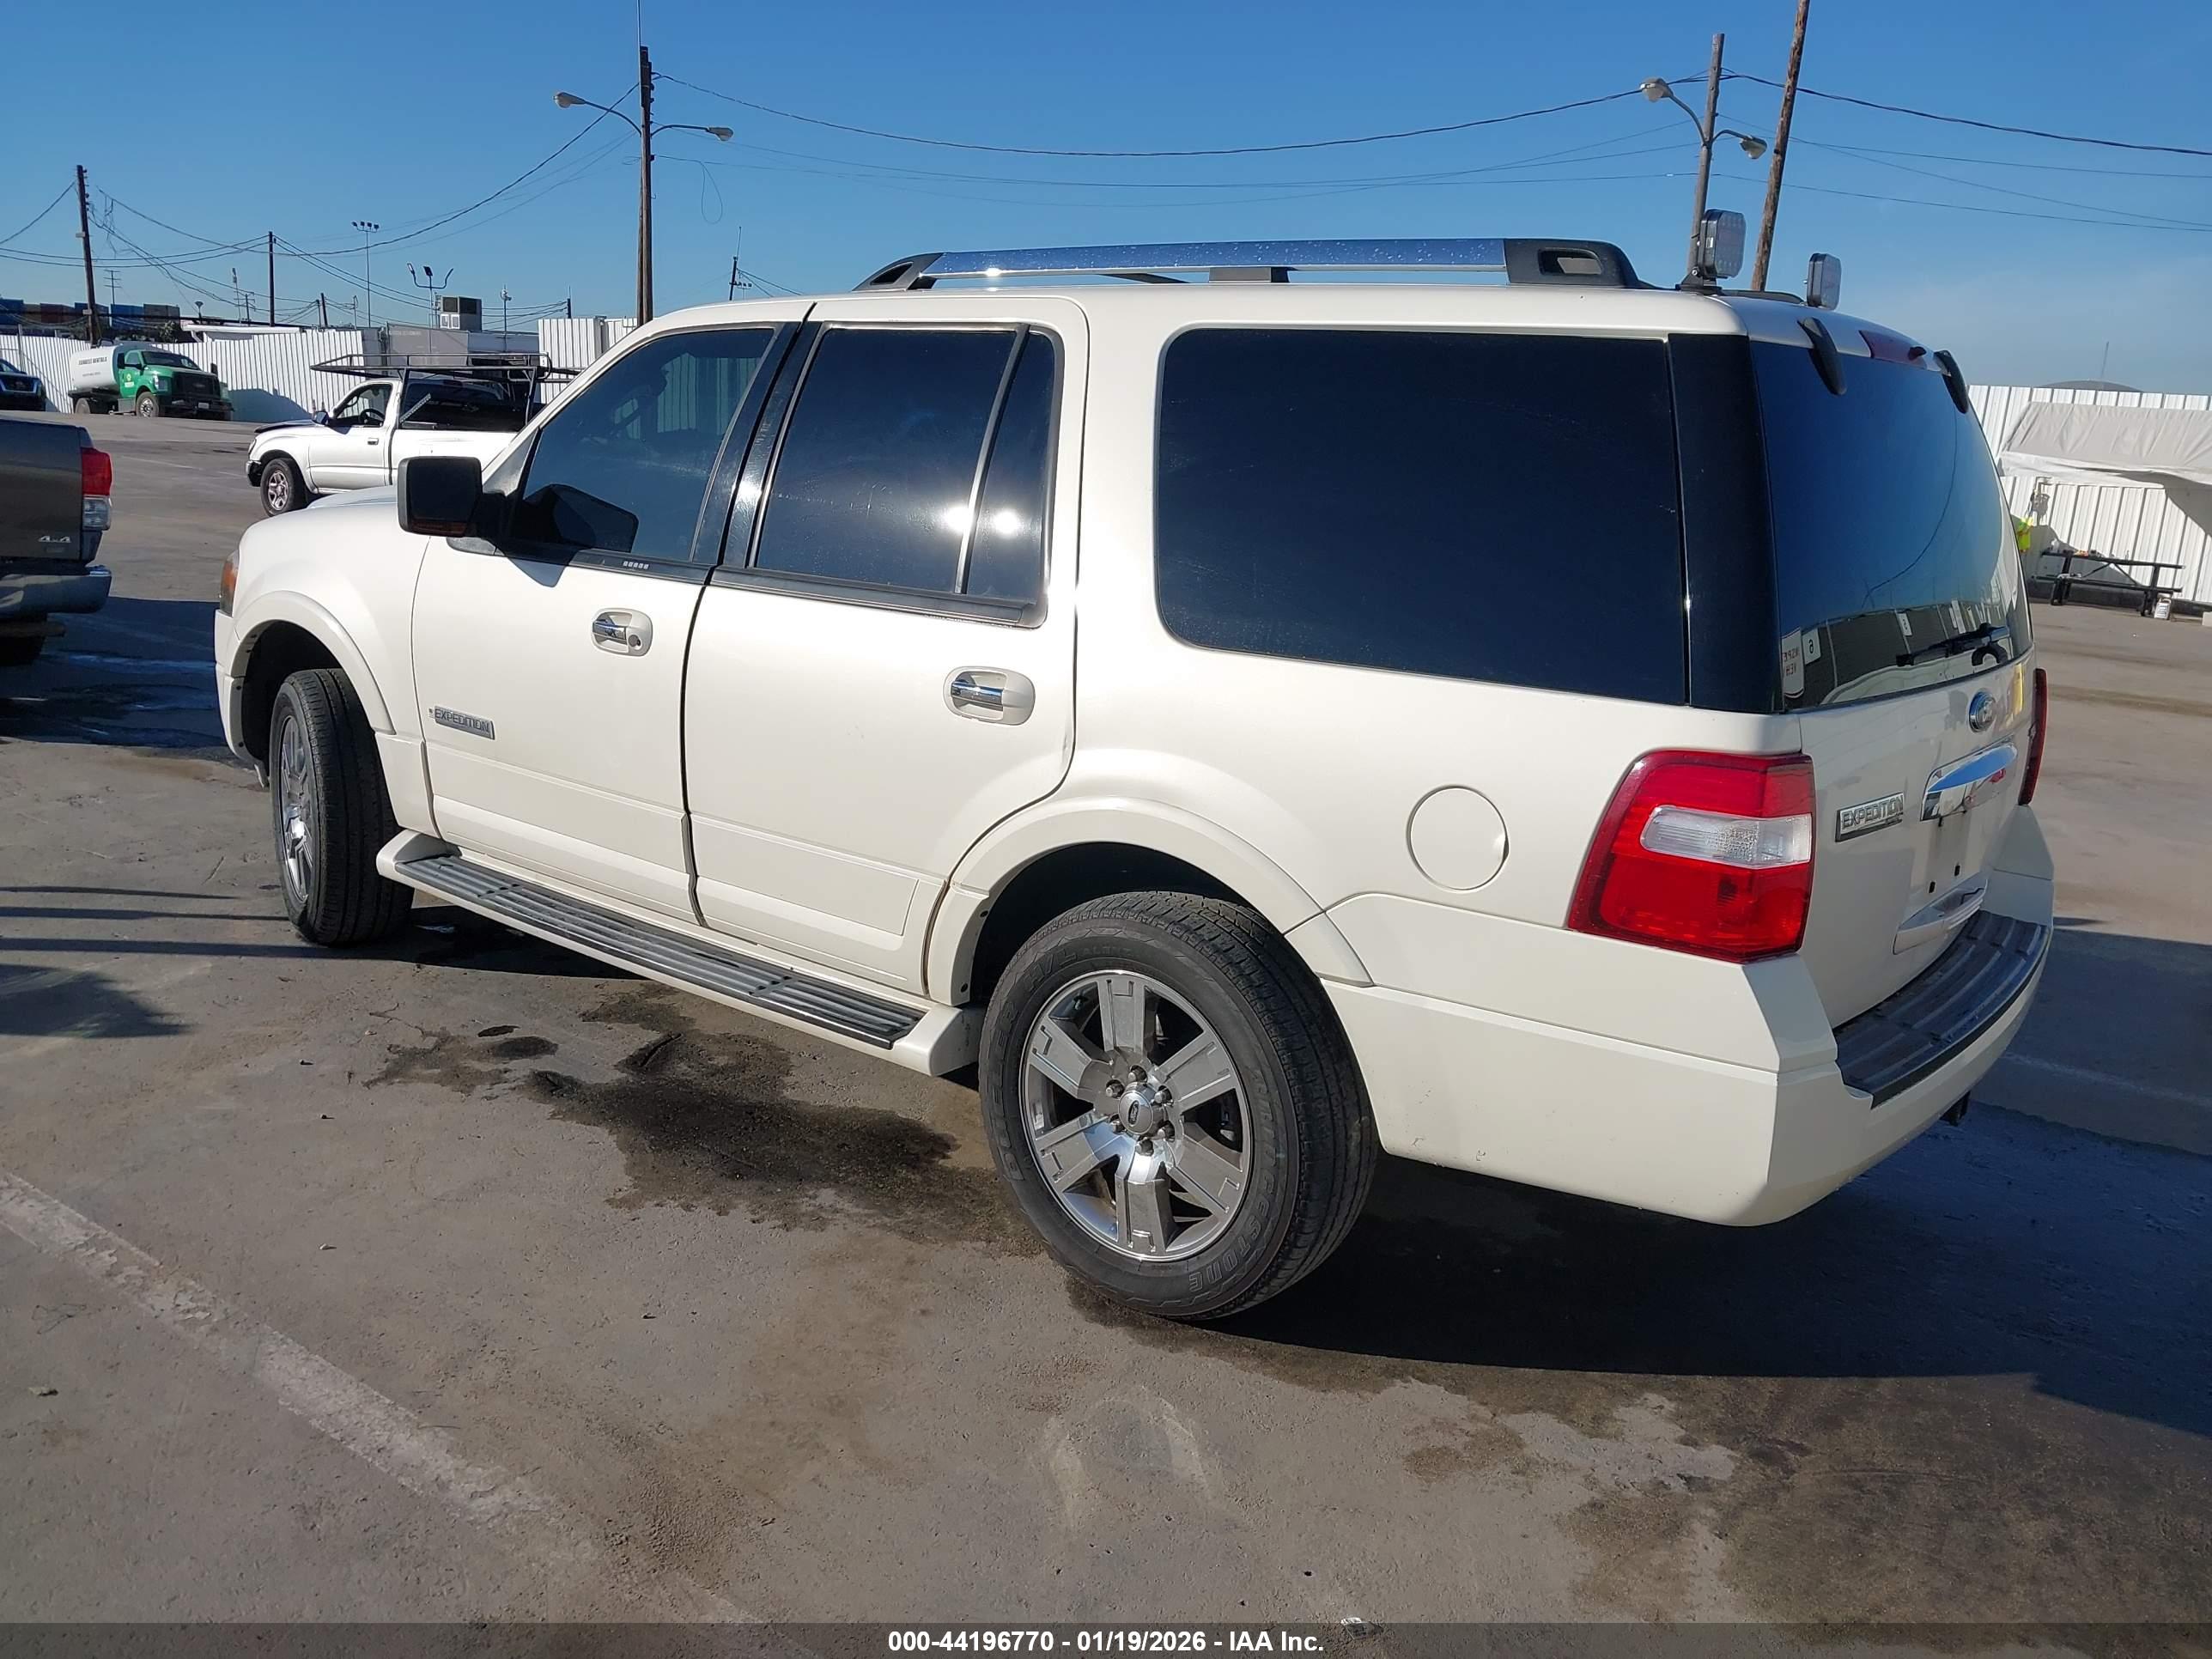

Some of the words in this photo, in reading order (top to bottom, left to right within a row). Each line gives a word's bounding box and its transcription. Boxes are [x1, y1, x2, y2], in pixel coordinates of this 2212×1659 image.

[38, 535, 71, 544] 4x4
[434, 708, 490, 733] EXPEDITION
[1841, 794, 1904, 830] EXPEDITION
